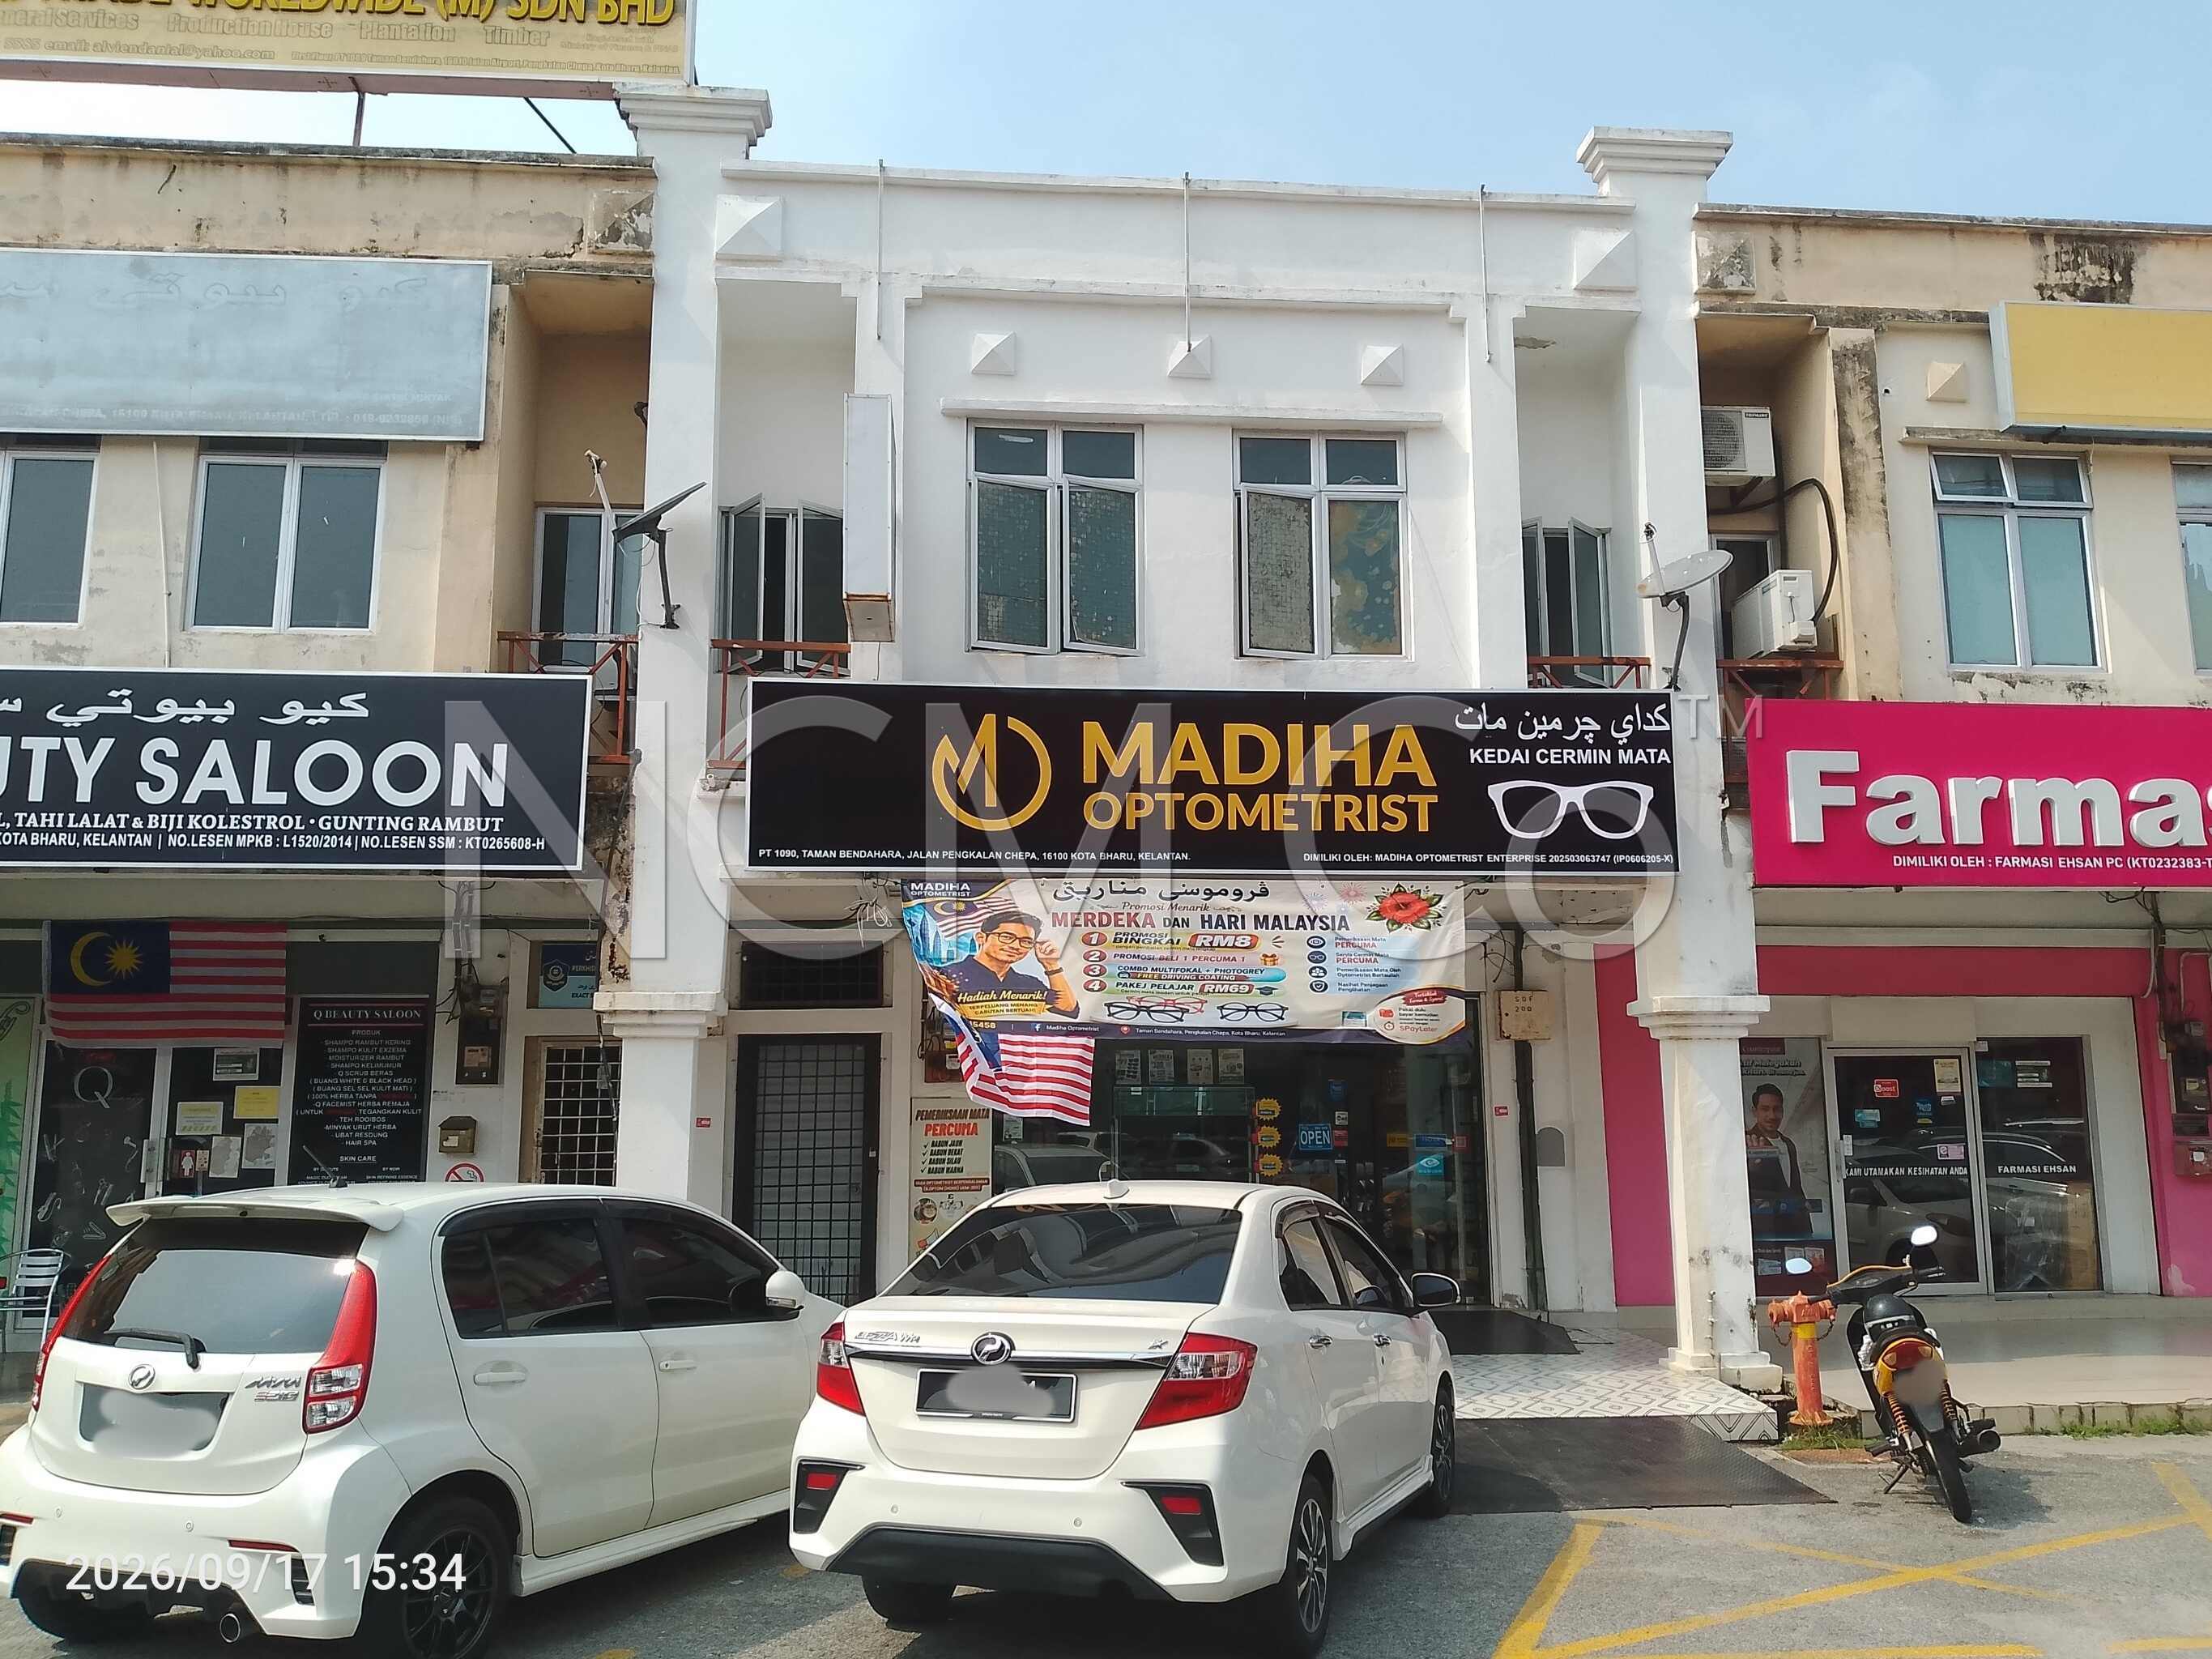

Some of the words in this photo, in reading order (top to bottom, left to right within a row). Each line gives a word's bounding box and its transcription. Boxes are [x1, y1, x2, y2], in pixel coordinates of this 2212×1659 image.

[54, 8, 139, 30] Services
[168, 14, 270, 37] Production
[274, 20, 333, 39] House
[360, 23, 456, 42] Plantation
[485, 25, 550, 47] Timber
[1083, 721, 1438, 787] MADIHA
[1470, 748, 1530, 765] KEDAI
[1536, 748, 1611, 765] CERMIN
[1618, 749, 1671, 765] MATA
[0, 736, 116, 803] TY
[136, 737, 508, 808] SALOON
[1786, 749, 2212, 848] Farma
[1083, 791, 1438, 832] OPTOMETRIST
[15, 812, 64, 829] TAHI
[67, 813, 130, 829] LALAT
[131, 816, 144, 830] &
[147, 814, 184, 833] BIJI
[187, 815, 305, 831] KOLESTROL
[318, 816, 414, 831] GUNTING
[418, 817, 503, 833] RAMBUT
[31, 833, 80, 848] BHARU,
[83, 834, 152, 847] KELANTAN
[168, 834, 235, 847] NO.LESEN
[237, 835, 273, 848] MPKB
[283, 835, 352, 850] L1520/2014
[361, 835, 425, 849] NO.LESEN
[428, 836, 455, 850] SSM
[465, 837, 545, 851] KT0265608-H
[759, 850, 771, 858] PT
[774, 850, 799, 859] 1090,
[803, 851, 836, 859] TAMAN
[839, 851, 904, 859] BENDAHARA,
[907, 851, 940, 859] JALAN
[942, 851, 1002, 860] PENGKALAN
[1004, 851, 1040, 861] CHEPA,
[1042, 852, 1068, 860] 16100
[1071, 852, 1097, 860] KOTA
[1100, 852, 1135, 862] BHARU,
[1138, 852, 1191, 861] KELANTAN.
[1303, 853, 1341, 862] DIMILIKI
[1344, 853, 1373, 862] OLEH:
[1375, 853, 1413, 862] MADIHA
[1415, 854, 1483, 863] OPTOMETRIST
[1487, 854, 1547, 863] ENTERPRISE
[1549, 855, 1611, 863] 202503063747
[1613, 854, 1674, 864] (IP0606205-X)
[1893, 855, 1947, 868] DIMILIKI
[1950, 856, 1984, 868] OLEH
[1995, 856, 2053, 868] FARMASI
[2058, 857, 2103, 868] EHSAN
[2106, 857, 2124, 868] PC
[910, 882, 970, 891] MADIHA
[1121, 901, 1165, 911] Promosi
[1167, 902, 1210, 912] Menarik
[1052, 911, 1156, 928] MERDEKA
[1163, 917, 1190, 928] DAN
[1200, 914, 1246, 930] HARI
[1254, 915, 1350, 932] MALAYSIA
[1112, 937, 1180, 945] BINGKAI
[1196, 935, 1251, 948] RM8
[1150, 983, 1195, 991] PELAJAR
[1203, 984, 1250, 993] RM69
[957, 991, 997, 1002] Hadiah
[998, 990, 1046, 1000] Menarik!
[325, 1010, 369, 1018] BEAUTY
[374, 1010, 421, 1018] SALOON
[969, 1108, 990, 1120] MATA
[924, 1123, 978, 1137] PERCUMA
[1300, 1130, 1330, 1145] OPEN
[1845, 1167, 1862, 1177] KAMI
[1864, 1167, 1904, 1176] UTAMAKAN
[1907, 1166, 1947, 1175] KESIHATAN
[1950, 1166, 1967, 1175] ANDA
[1998, 1165, 2040, 1174] FARMASI
[2044, 1165, 2076, 1173] EHSAN
